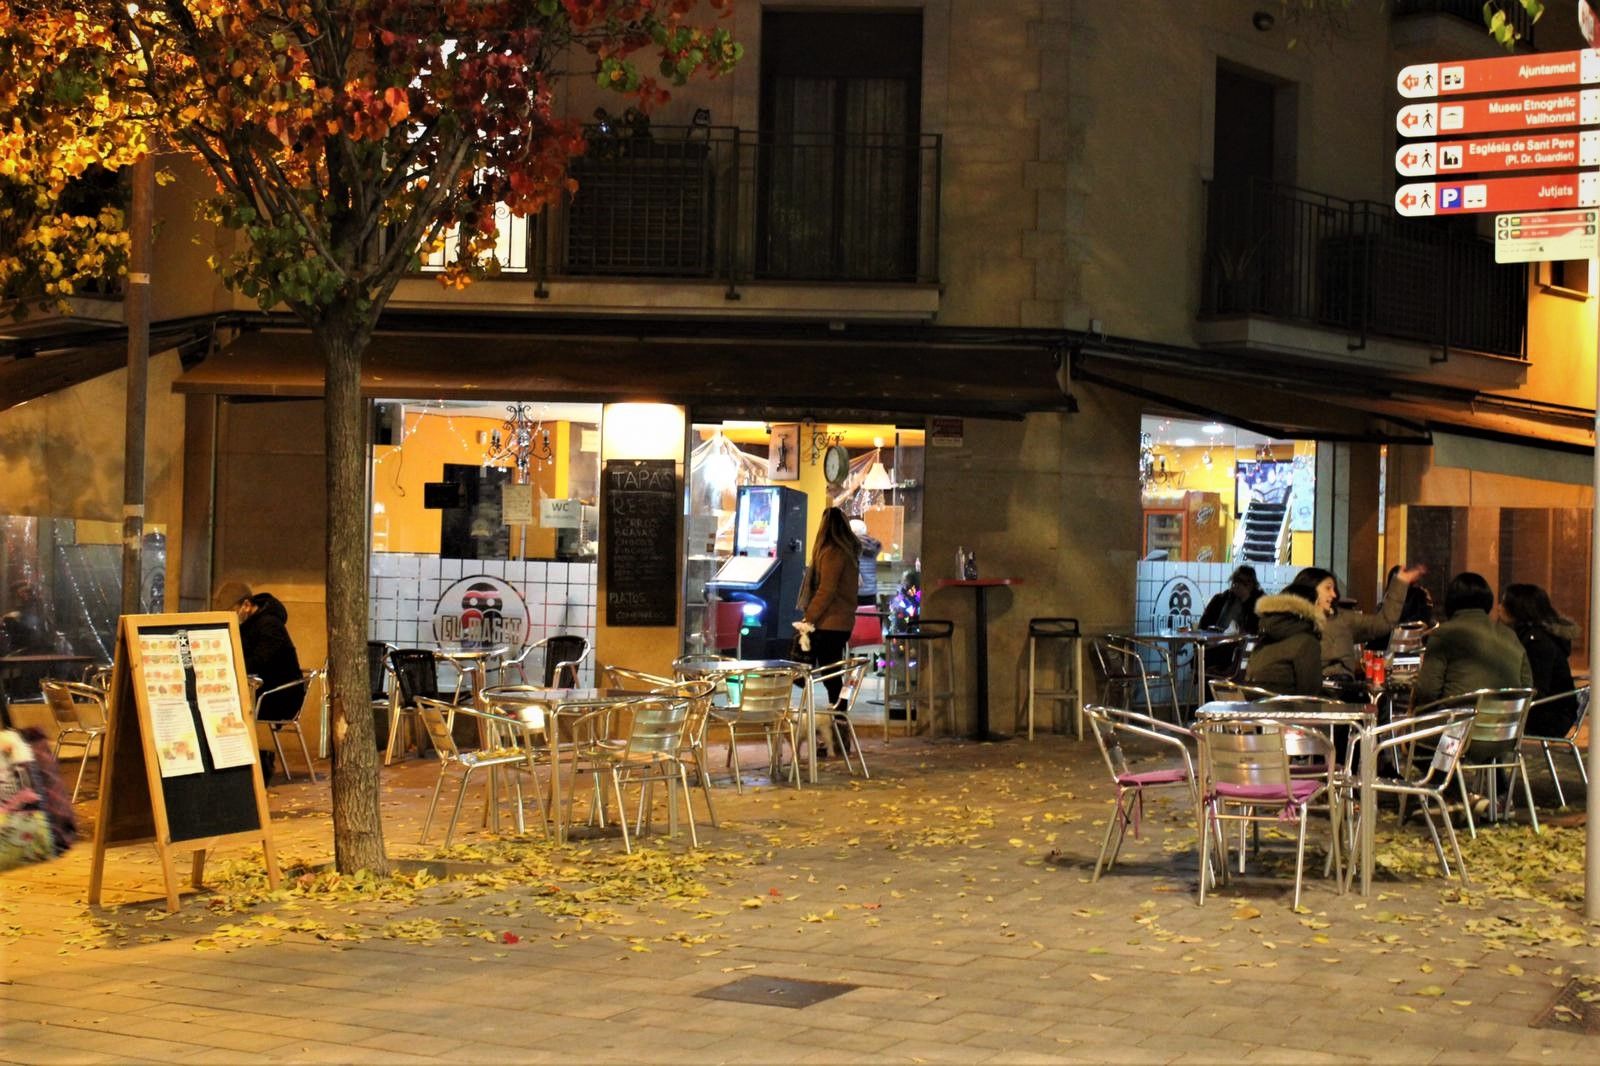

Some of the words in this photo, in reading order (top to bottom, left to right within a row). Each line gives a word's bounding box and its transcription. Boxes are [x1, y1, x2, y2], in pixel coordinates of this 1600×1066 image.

[1519, 62, 1576, 79] Ajuntament
[1489, 101, 1522, 114] Museu
[1524, 96, 1576, 112] Etnogràfic
[1525, 111, 1576, 125] Vallhonrat
[1469, 141, 1511, 156] Església
[1512, 141, 1525, 151] de
[1527, 139, 1550, 151] Sant
[1551, 138, 1575, 149] Pere
[1505, 154, 1519, 166] (Pl.
[1520, 153, 1533, 164] Dr.
[1534, 151, 1575, 163] Guardiet)
[1538, 185, 1574, 198] Jutjats
[612, 469, 673, 490] TAPAS
[551, 502, 569, 512] WC
